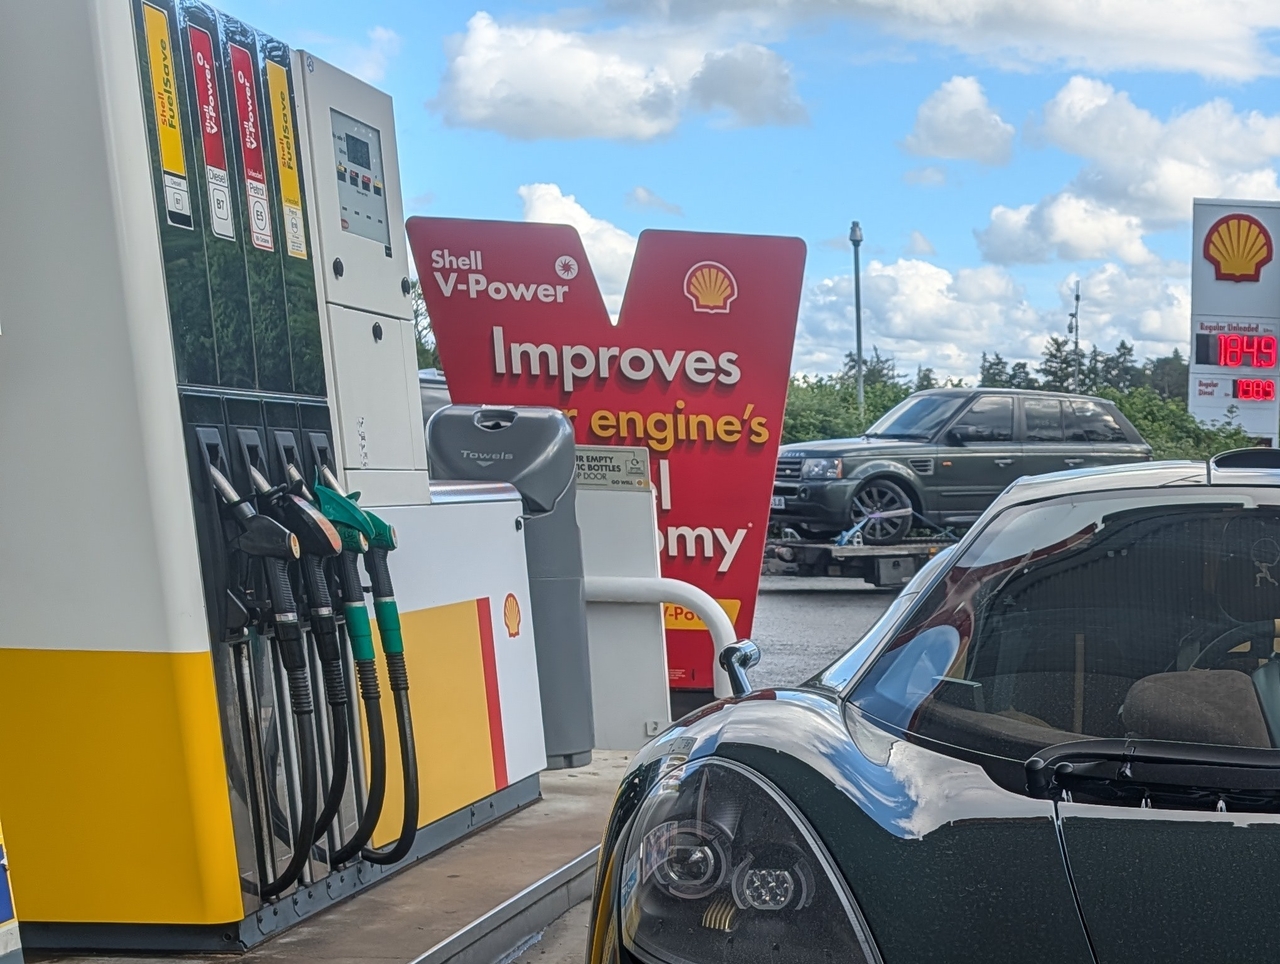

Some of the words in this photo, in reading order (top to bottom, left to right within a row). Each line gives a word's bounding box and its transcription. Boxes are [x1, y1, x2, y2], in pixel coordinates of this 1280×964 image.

[161, 39, 176, 129] FuelSave
[158, 92, 167, 126] Shell
[204, 60, 217, 134] V-Power
[203, 105, 211, 133] Shell
[245, 78, 257, 149] V-Power
[281, 91, 293, 170] FuelSave
[279, 138, 287, 168] Shell
[208, 168, 226, 184] Diesel
[249, 182, 265, 196] Petrol
[216, 198, 225, 211] B7
[256, 209, 264, 222] E5
[431, 249, 482, 270] Shell
[433, 271, 569, 303] V-Power
[1200, 322, 1225, 333] Regular
[1227, 323, 1259, 332] Unleaded
[493, 326, 741, 392] Improves
[590, 400, 769, 451] engine's
[461, 450, 513, 460] Towels
[586, 455, 614, 463] EMPTY
[583, 472, 607, 480] DOOR
[588, 464, 621, 472] BOTTLES
